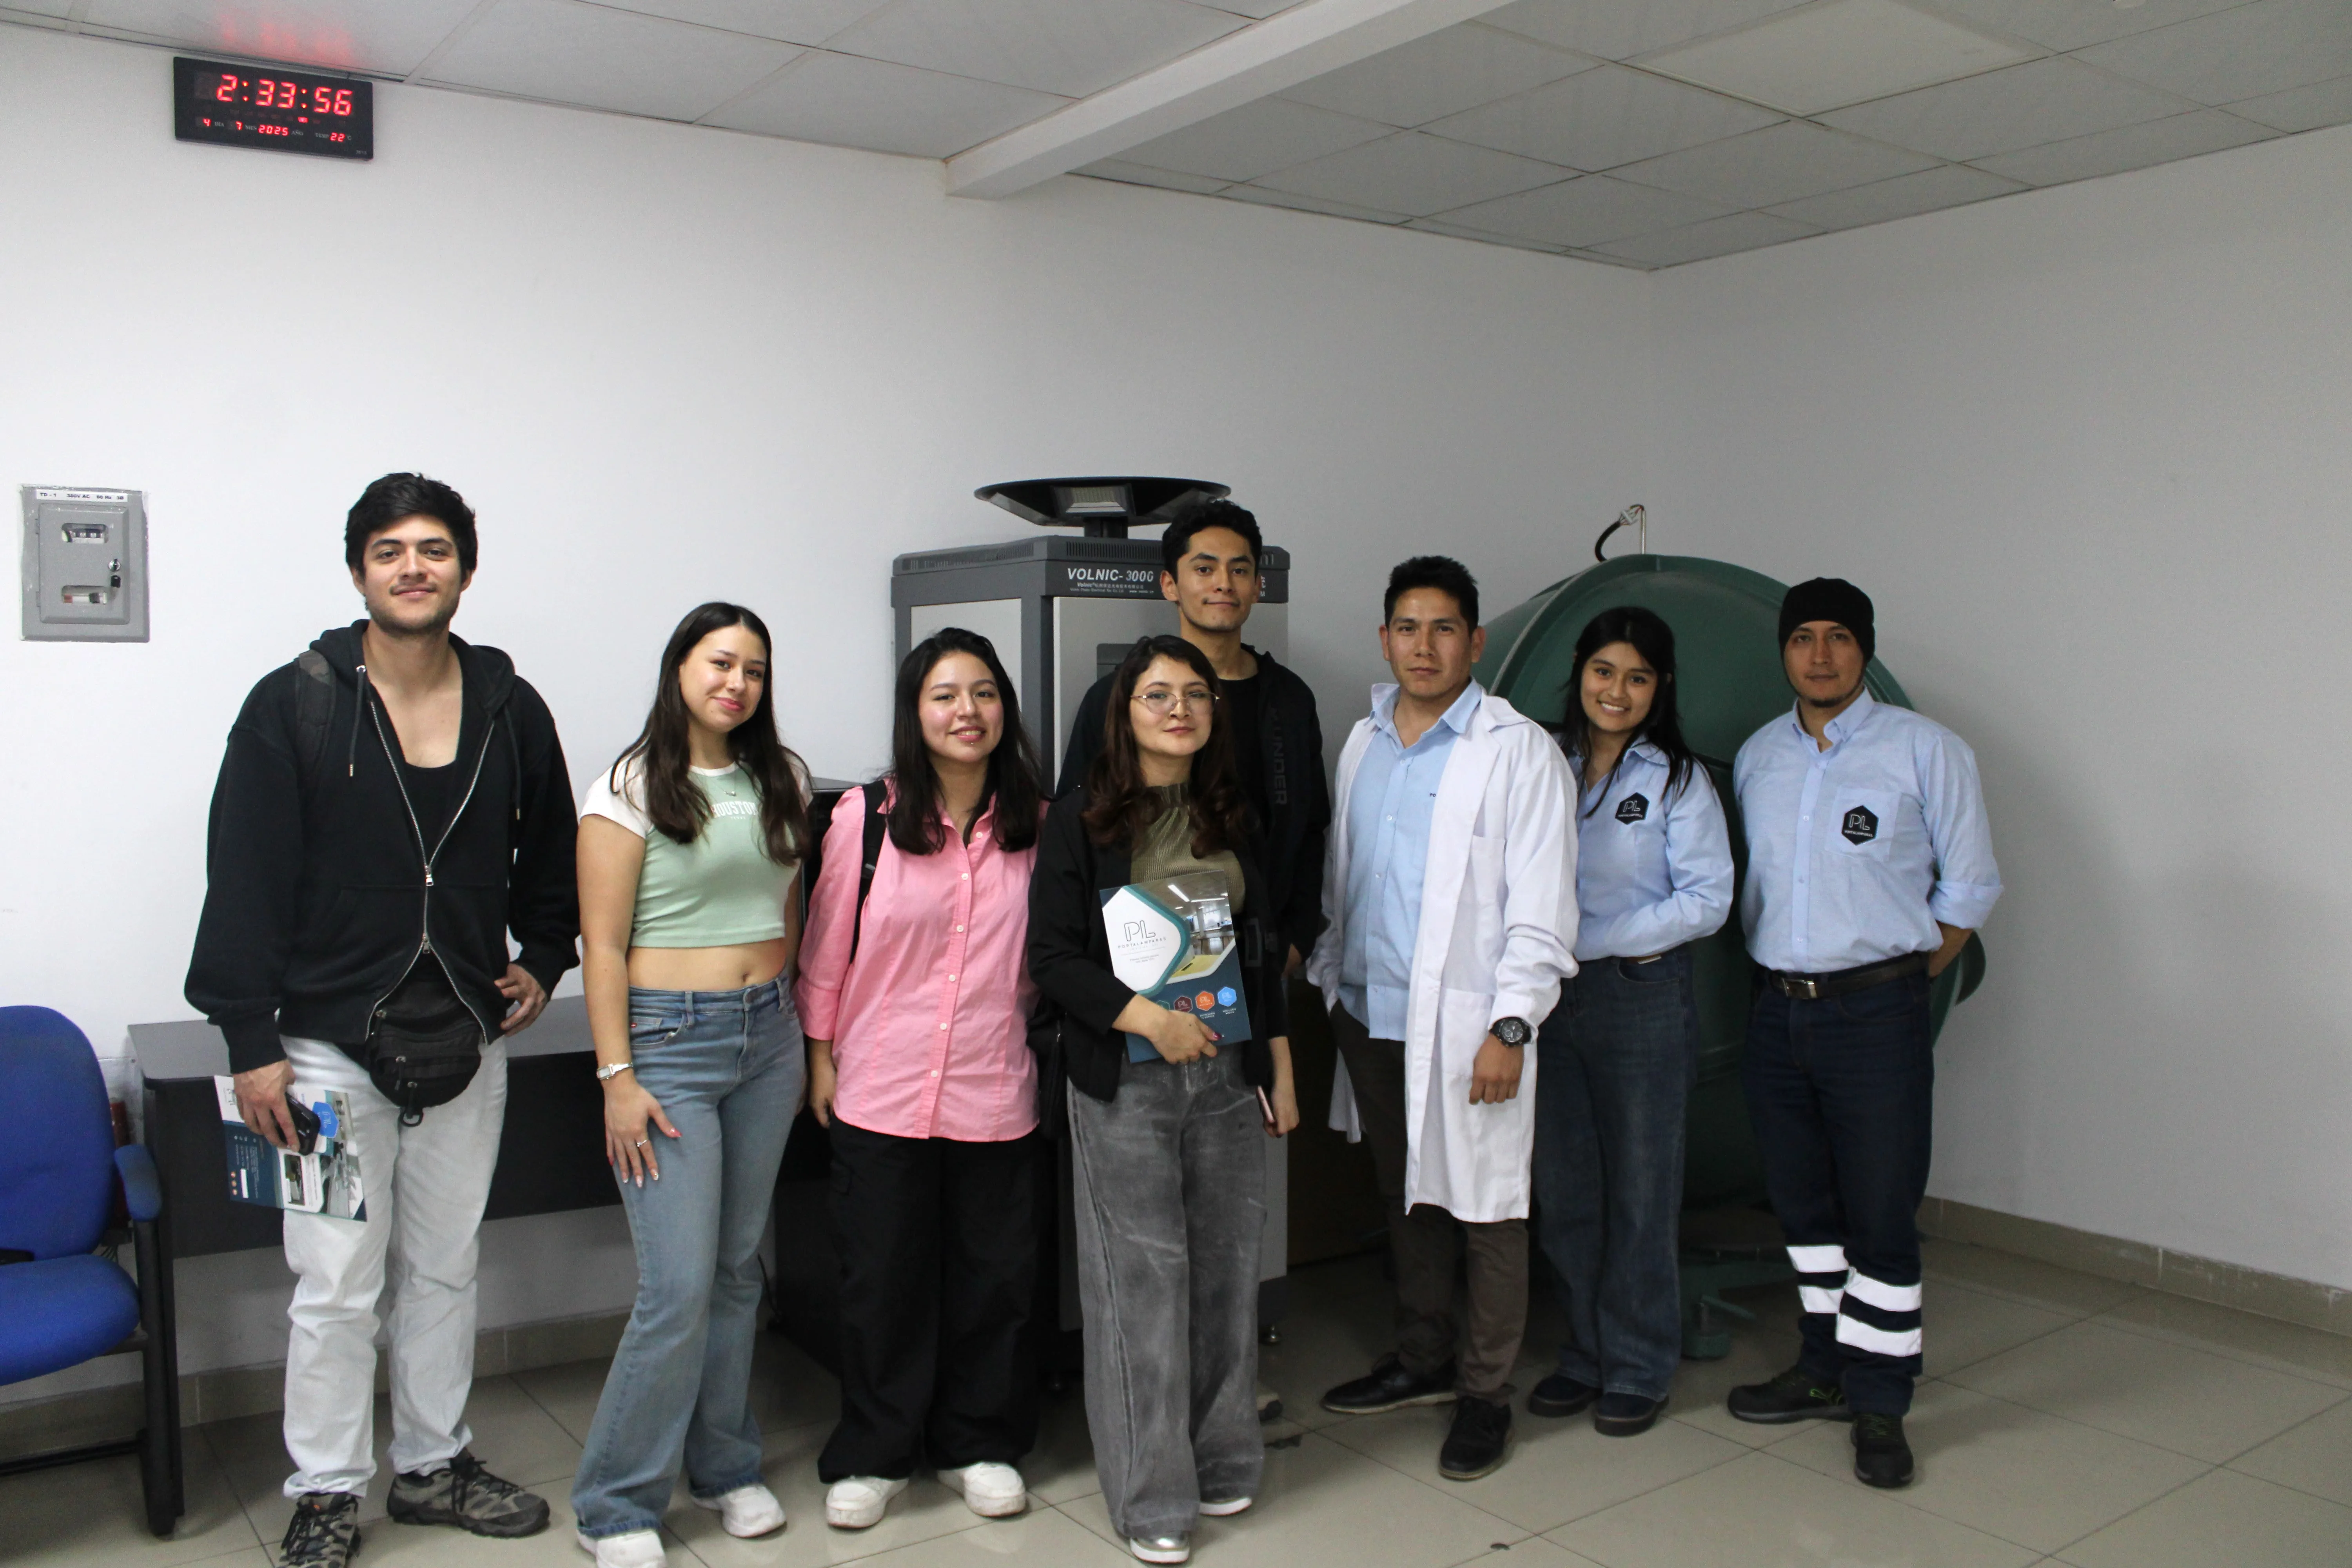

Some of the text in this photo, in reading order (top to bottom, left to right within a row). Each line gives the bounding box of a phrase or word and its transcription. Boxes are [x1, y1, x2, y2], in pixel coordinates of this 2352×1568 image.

[216, 74, 352, 116] 2:33:56
[203, 118, 211, 127] 4
[236, 120, 243, 131] 7
[258, 124, 289, 136] 2025
[330, 132, 345, 142] 22
[1273, 726, 1287, 805] UNDER
[1622, 800, 1641, 813] PL
[1849, 813, 1870, 831] PL
[1124, 920, 1156, 942] PL
